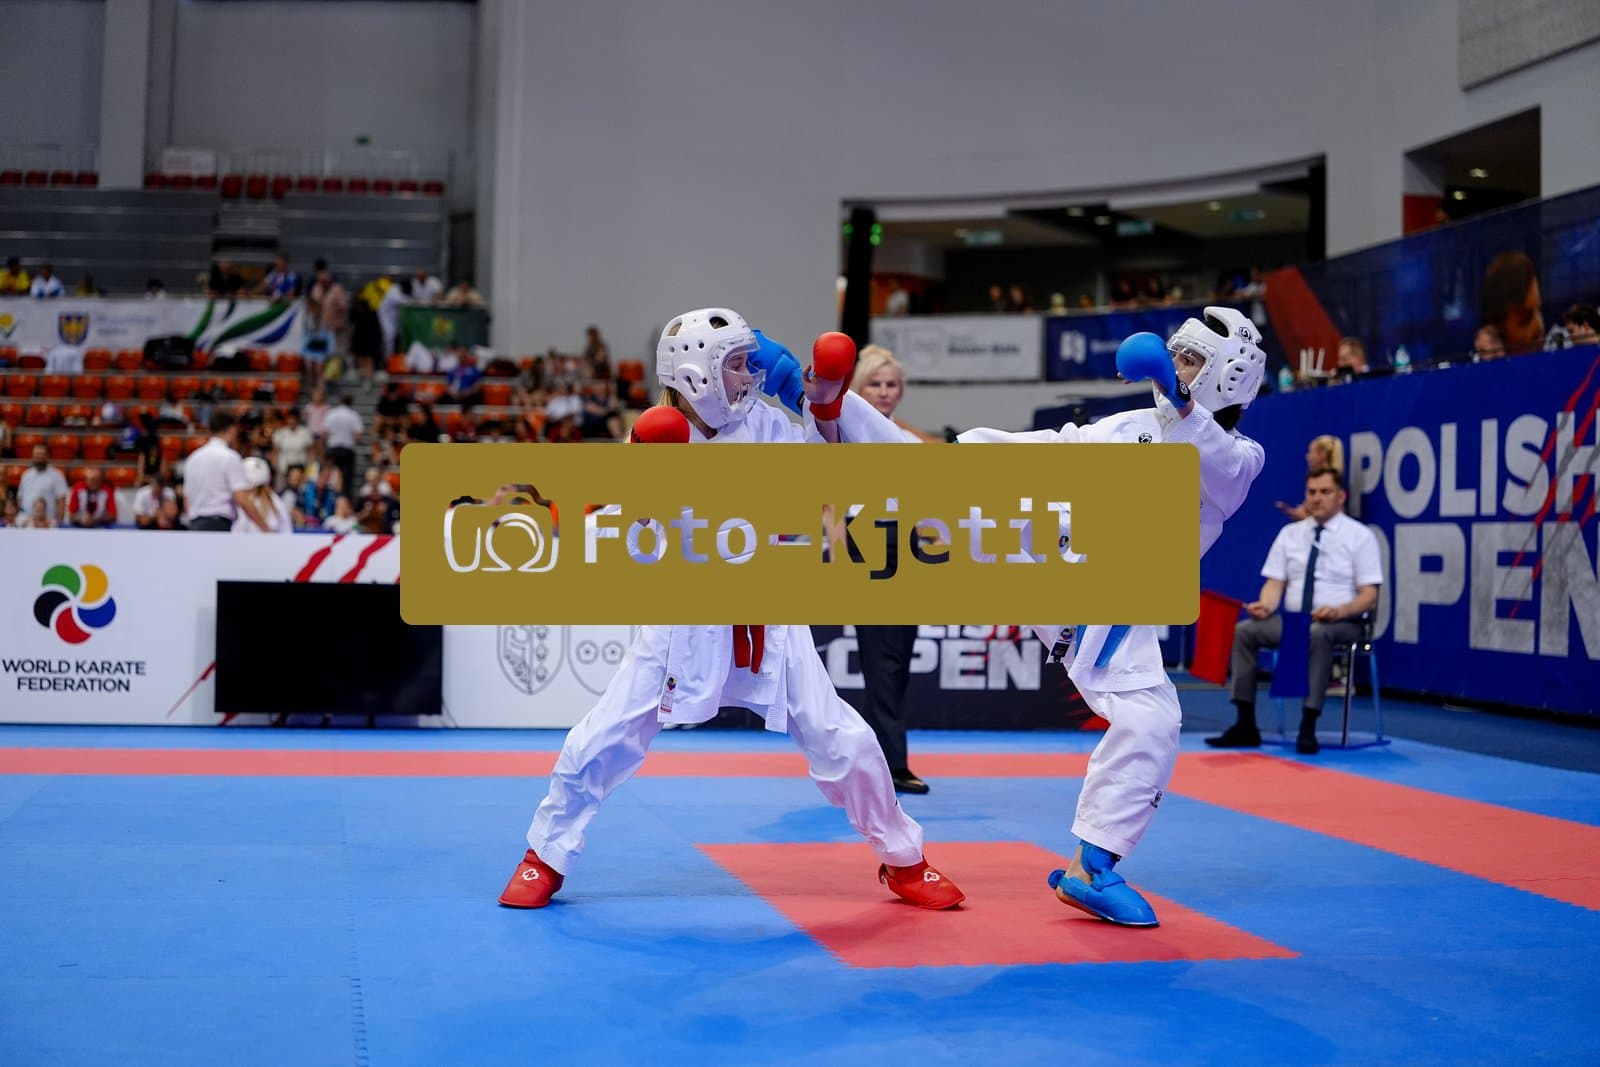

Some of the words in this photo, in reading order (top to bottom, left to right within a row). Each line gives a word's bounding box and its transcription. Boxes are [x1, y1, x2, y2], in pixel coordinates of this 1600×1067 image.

[1349, 409, 1600, 517] POLISH
[2, 659, 71, 674] WORLD
[75, 660, 145, 675] KARATE
[17, 677, 131, 692] FEDERATION
